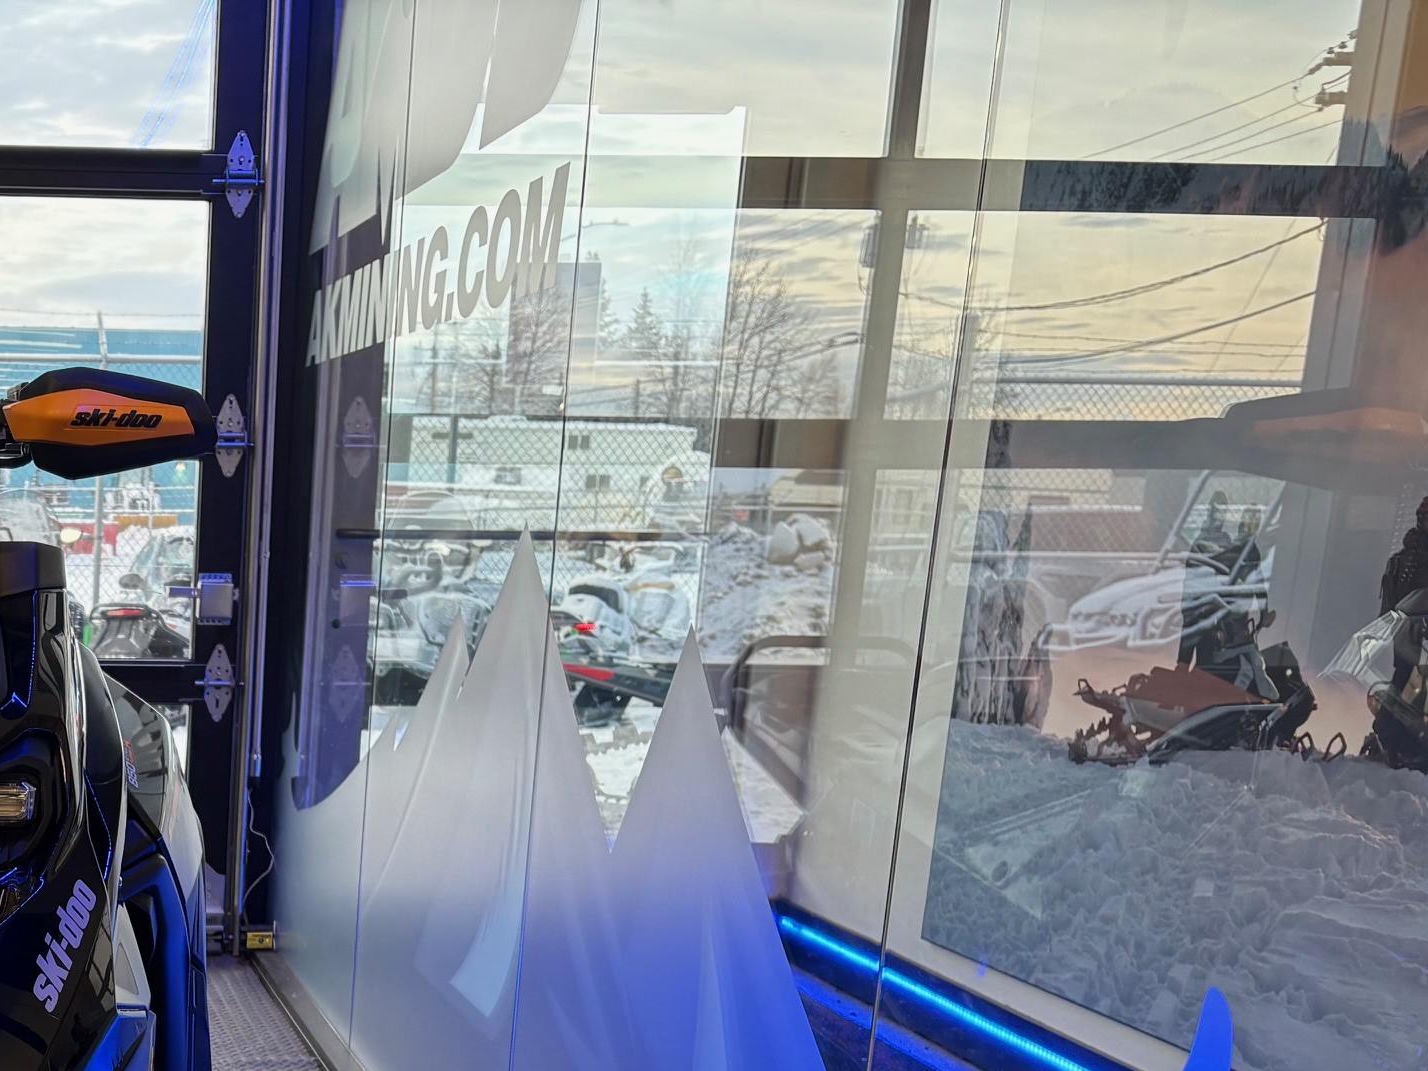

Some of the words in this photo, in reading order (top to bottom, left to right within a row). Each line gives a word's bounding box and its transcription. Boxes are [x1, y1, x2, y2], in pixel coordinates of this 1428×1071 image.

[305, 161, 571, 368] AKMINING.COM
[70, 408, 163, 429] ski-doo
[33, 879, 97, 1013] ski-doo
